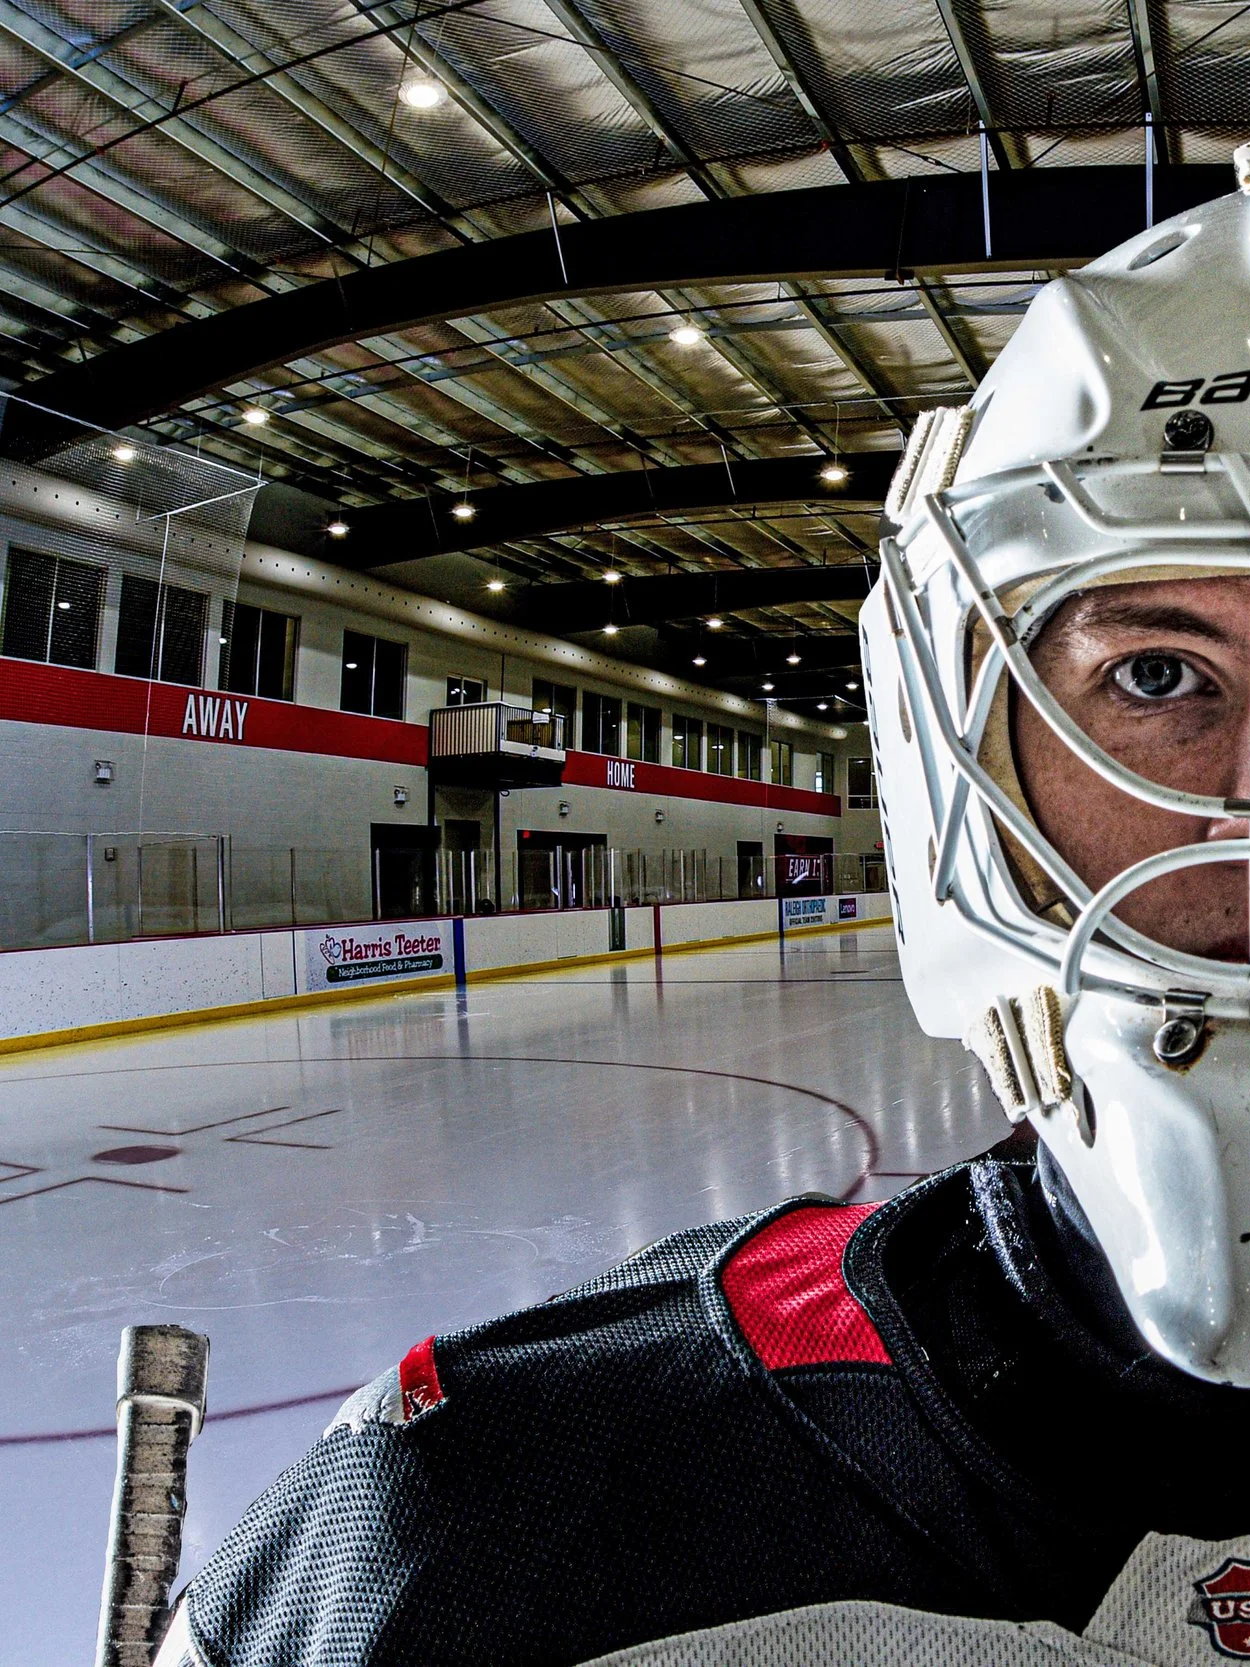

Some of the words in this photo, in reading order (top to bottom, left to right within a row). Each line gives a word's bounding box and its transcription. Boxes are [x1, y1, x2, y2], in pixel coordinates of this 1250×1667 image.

[182, 694, 248, 740] AWAY
[607, 760, 635, 789] HOME
[788, 859, 811, 877] EARN
[341, 937, 392, 962] Harris
[395, 934, 440, 956] Teeter
[338, 963, 381, 978] Neighborhood
[382, 961, 397, 972] Food
[398, 960, 404, 970] &
[404, 959, 433, 970] Pharmacy
